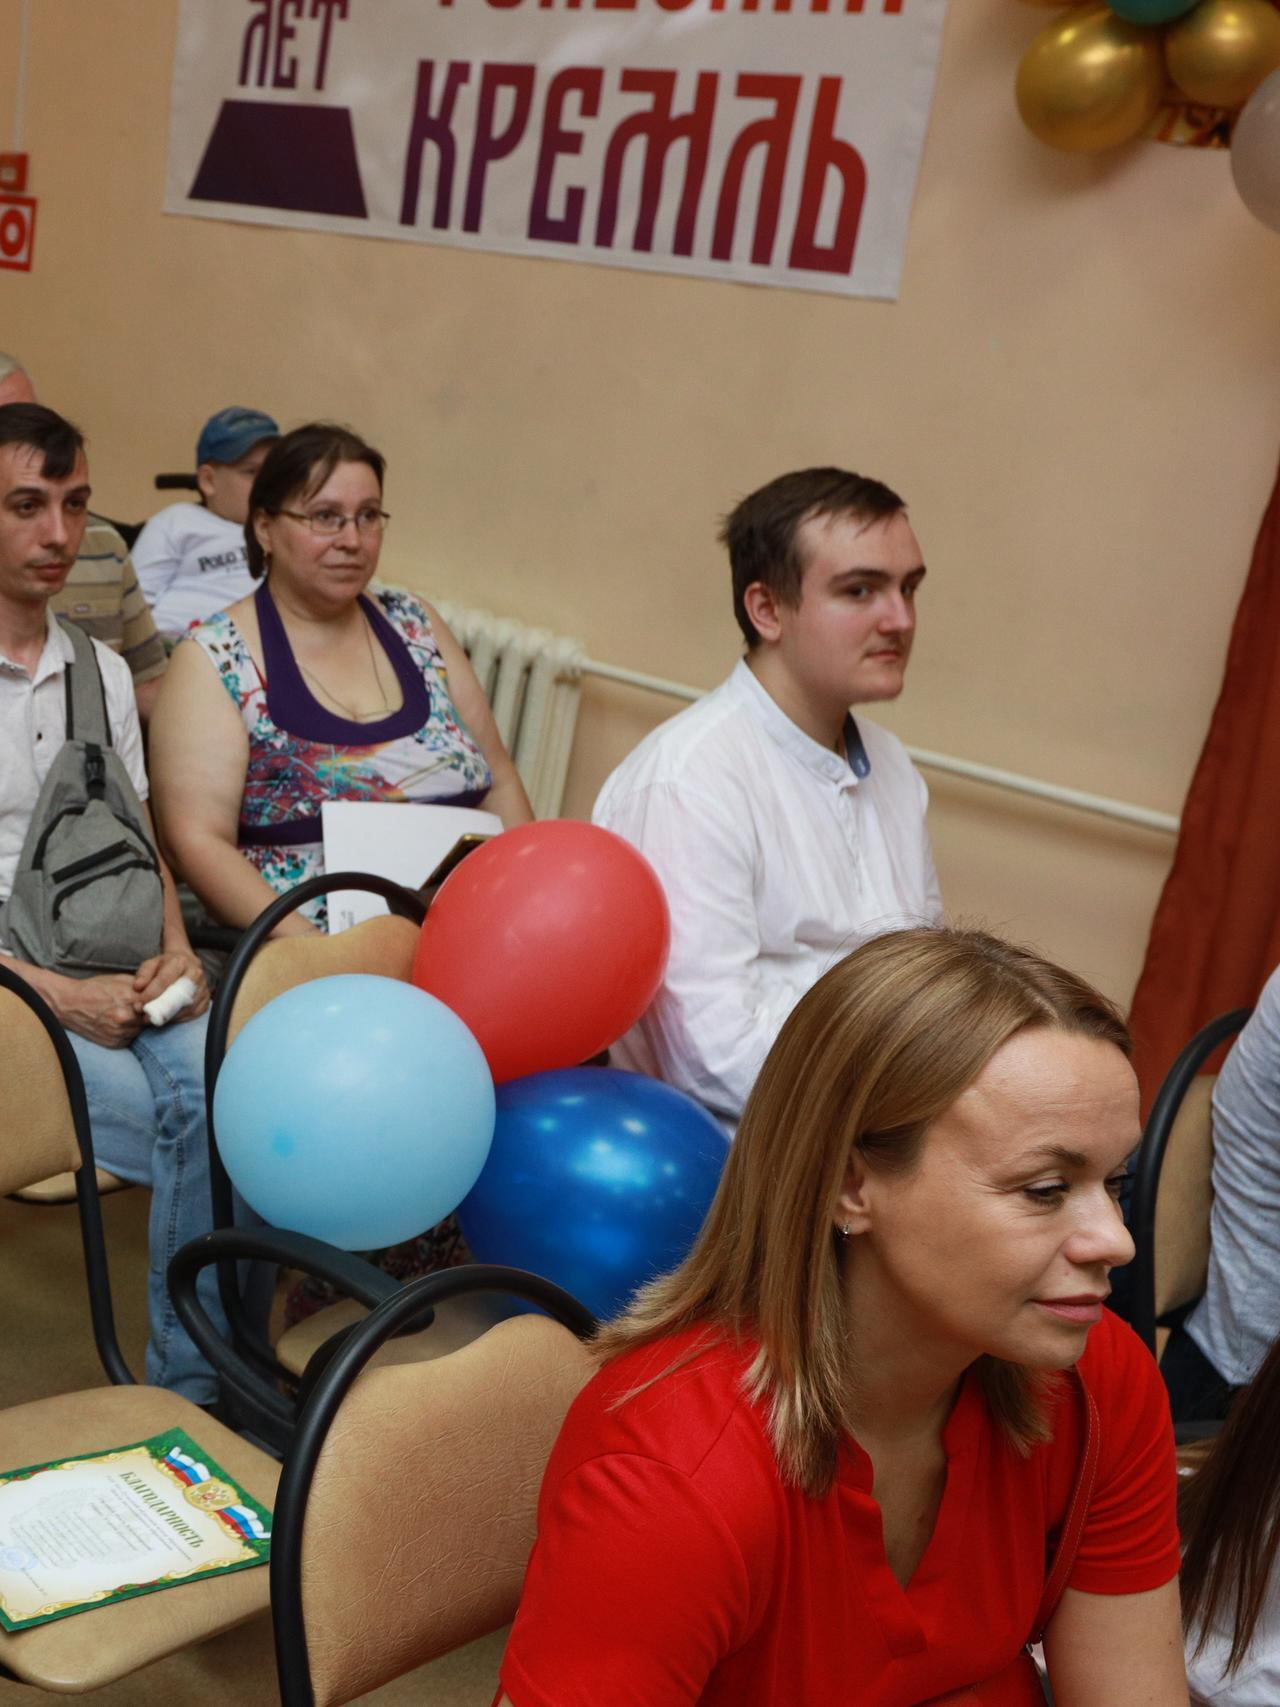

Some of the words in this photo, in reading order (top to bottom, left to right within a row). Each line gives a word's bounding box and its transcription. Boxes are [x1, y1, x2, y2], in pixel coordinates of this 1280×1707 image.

[238, 0, 350, 91] ЛЕТ
[399, 59, 868, 275] КРЕМЛЬ
[120, 1472, 204, 1548] БЛАГОДАРНОСТЬ
